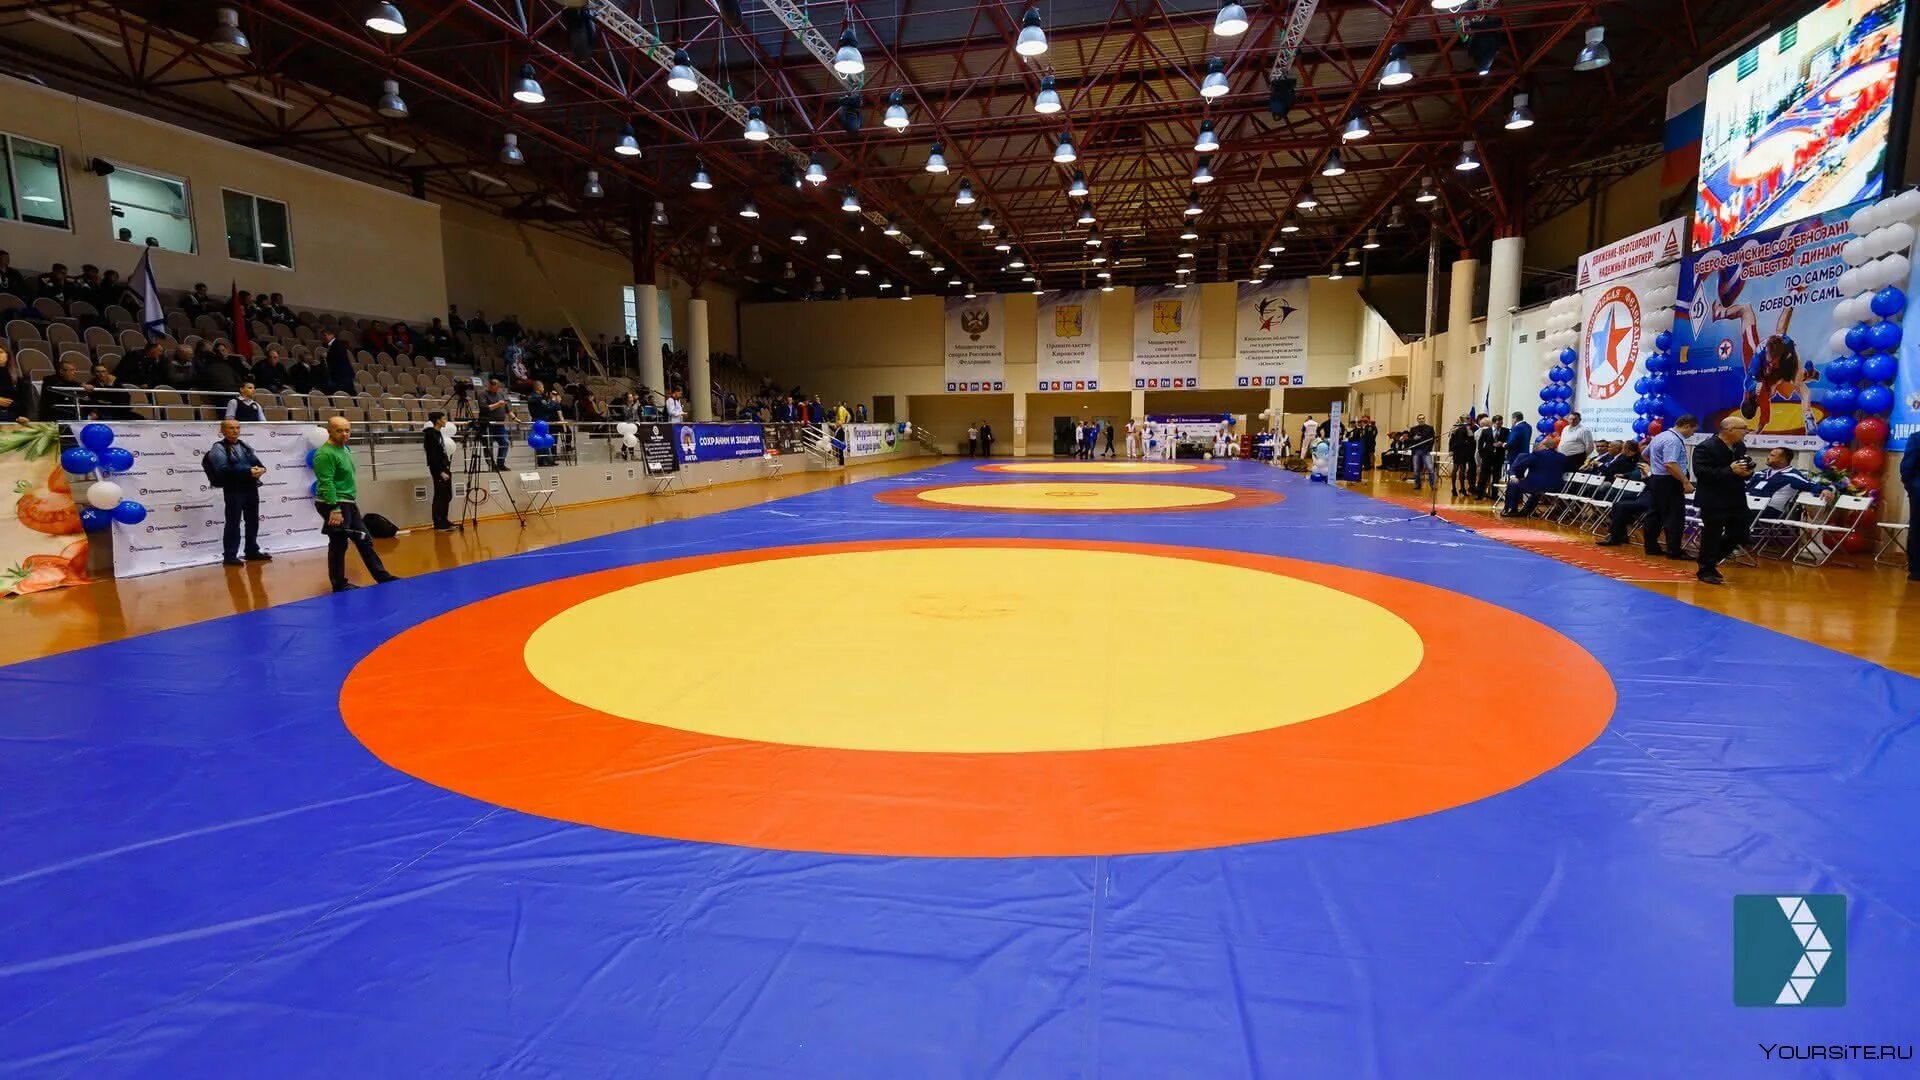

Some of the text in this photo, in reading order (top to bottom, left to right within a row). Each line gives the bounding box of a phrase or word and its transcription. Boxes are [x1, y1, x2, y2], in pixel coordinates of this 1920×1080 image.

[1694, 244, 1770, 273] ВСЕРОССИЙСКИЕ
[1741, 258, 1794, 280] ОБЩЕСТВА
[1784, 264, 1844, 288] ПО САМБО
[1759, 293, 1810, 312] БОЕВОМУ
[699, 437, 730, 446] СОХРАНИМ
